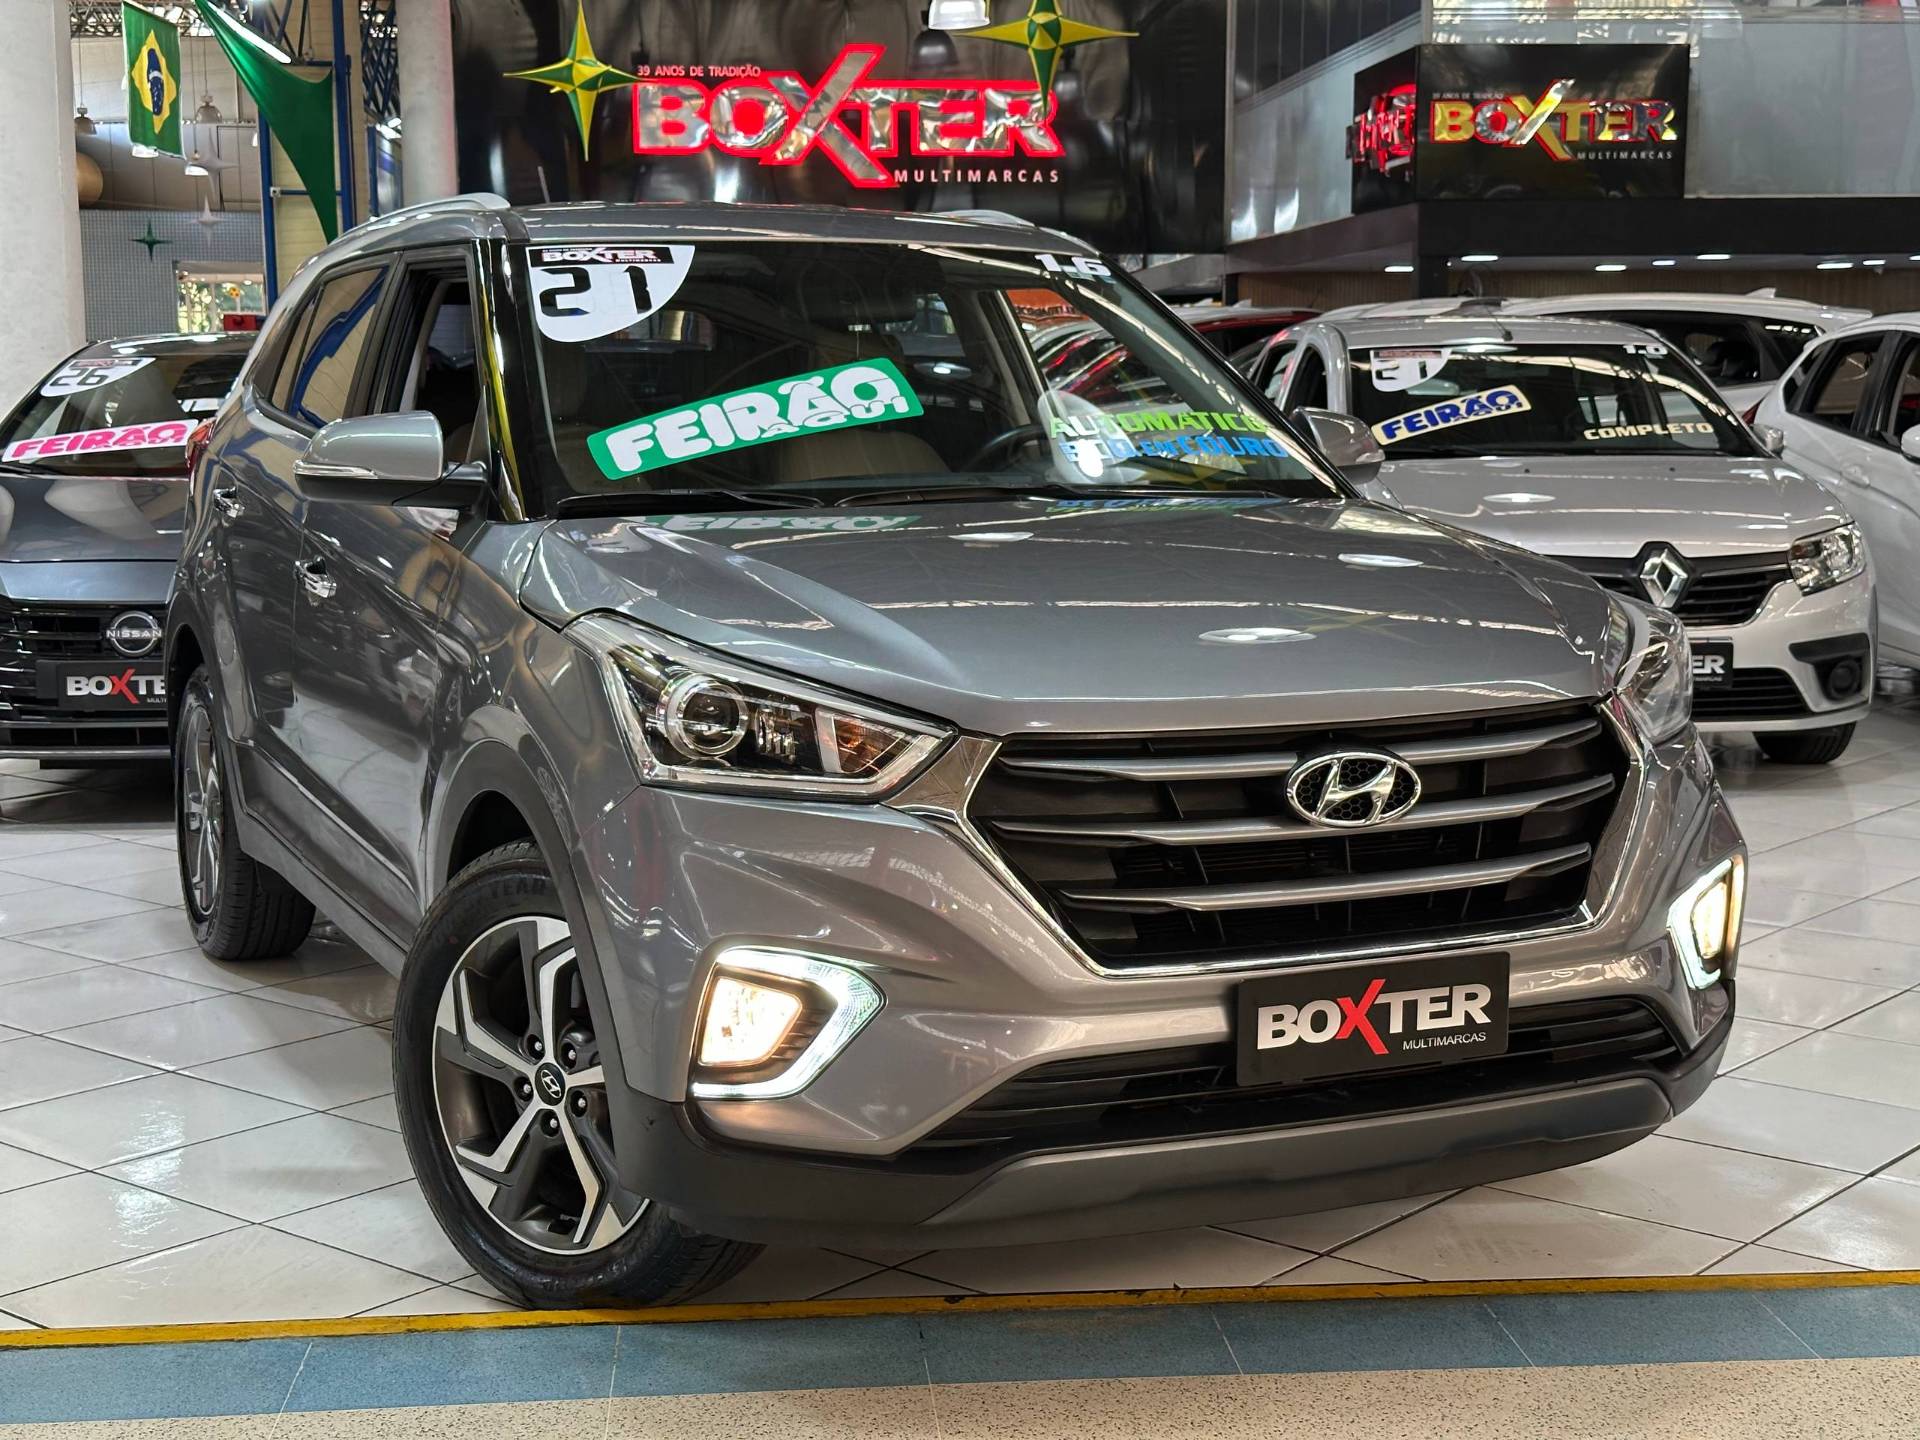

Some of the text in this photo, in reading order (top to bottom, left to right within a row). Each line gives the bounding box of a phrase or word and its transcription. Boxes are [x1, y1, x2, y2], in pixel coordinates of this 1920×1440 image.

[637, 63, 761, 78] 39 ANOS DE TRADIÇÃO
[633, 43, 1066, 188] BOXTER
[1429, 79, 1678, 161] BOXTER
[1577, 151, 1673, 161] MULTIMARCAS
[894, 168, 1060, 183] MULTIMARCAS
[541, 247, 658, 263] BOXTER
[1034, 254, 1111, 276] 1.6
[539, 265, 653, 317] 21
[50, 367, 109, 386] 26
[605, 366, 902, 472] FEIRÃO
[1381, 390, 1519, 440] FEIRÃO
[12, 423, 188, 458] FEIRÃO
[1583, 422, 1714, 440] COMPLETO
[106, 629, 162, 638] NISSAN
[1256, 978, 1492, 1055] BOXTER
[1402, 1031, 1487, 1051] MULTIMARCAS
